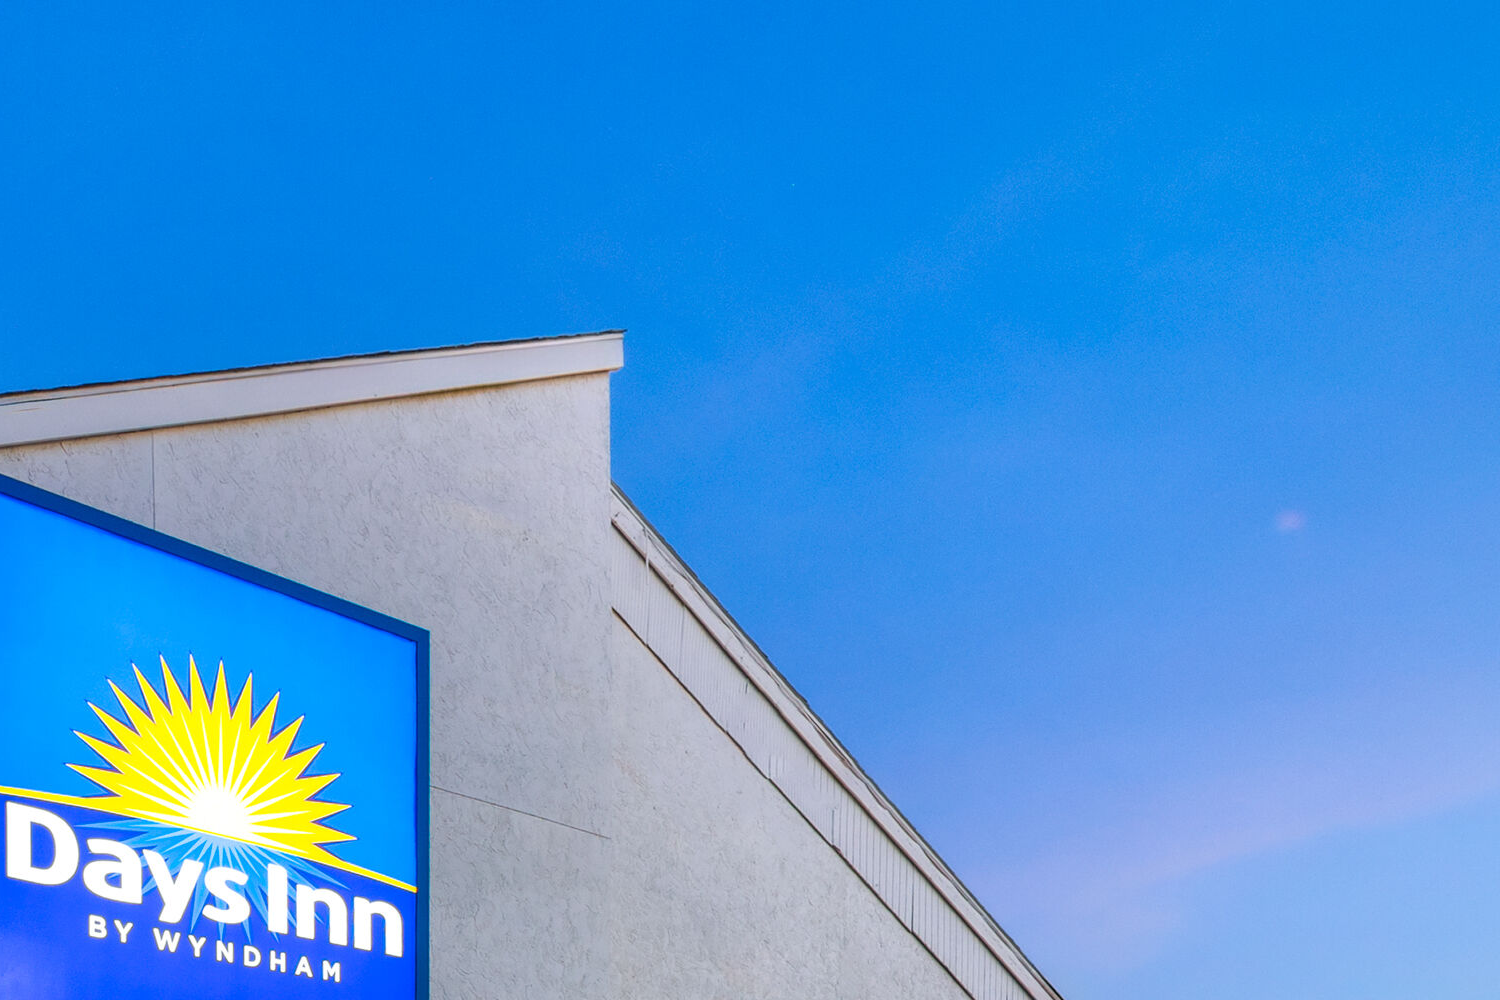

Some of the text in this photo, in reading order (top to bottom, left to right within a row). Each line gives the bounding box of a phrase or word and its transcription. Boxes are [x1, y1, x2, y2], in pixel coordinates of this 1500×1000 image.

[6, 801, 404, 957] Days Inn
[88, 914, 342, 983] BY WYNDHAM
